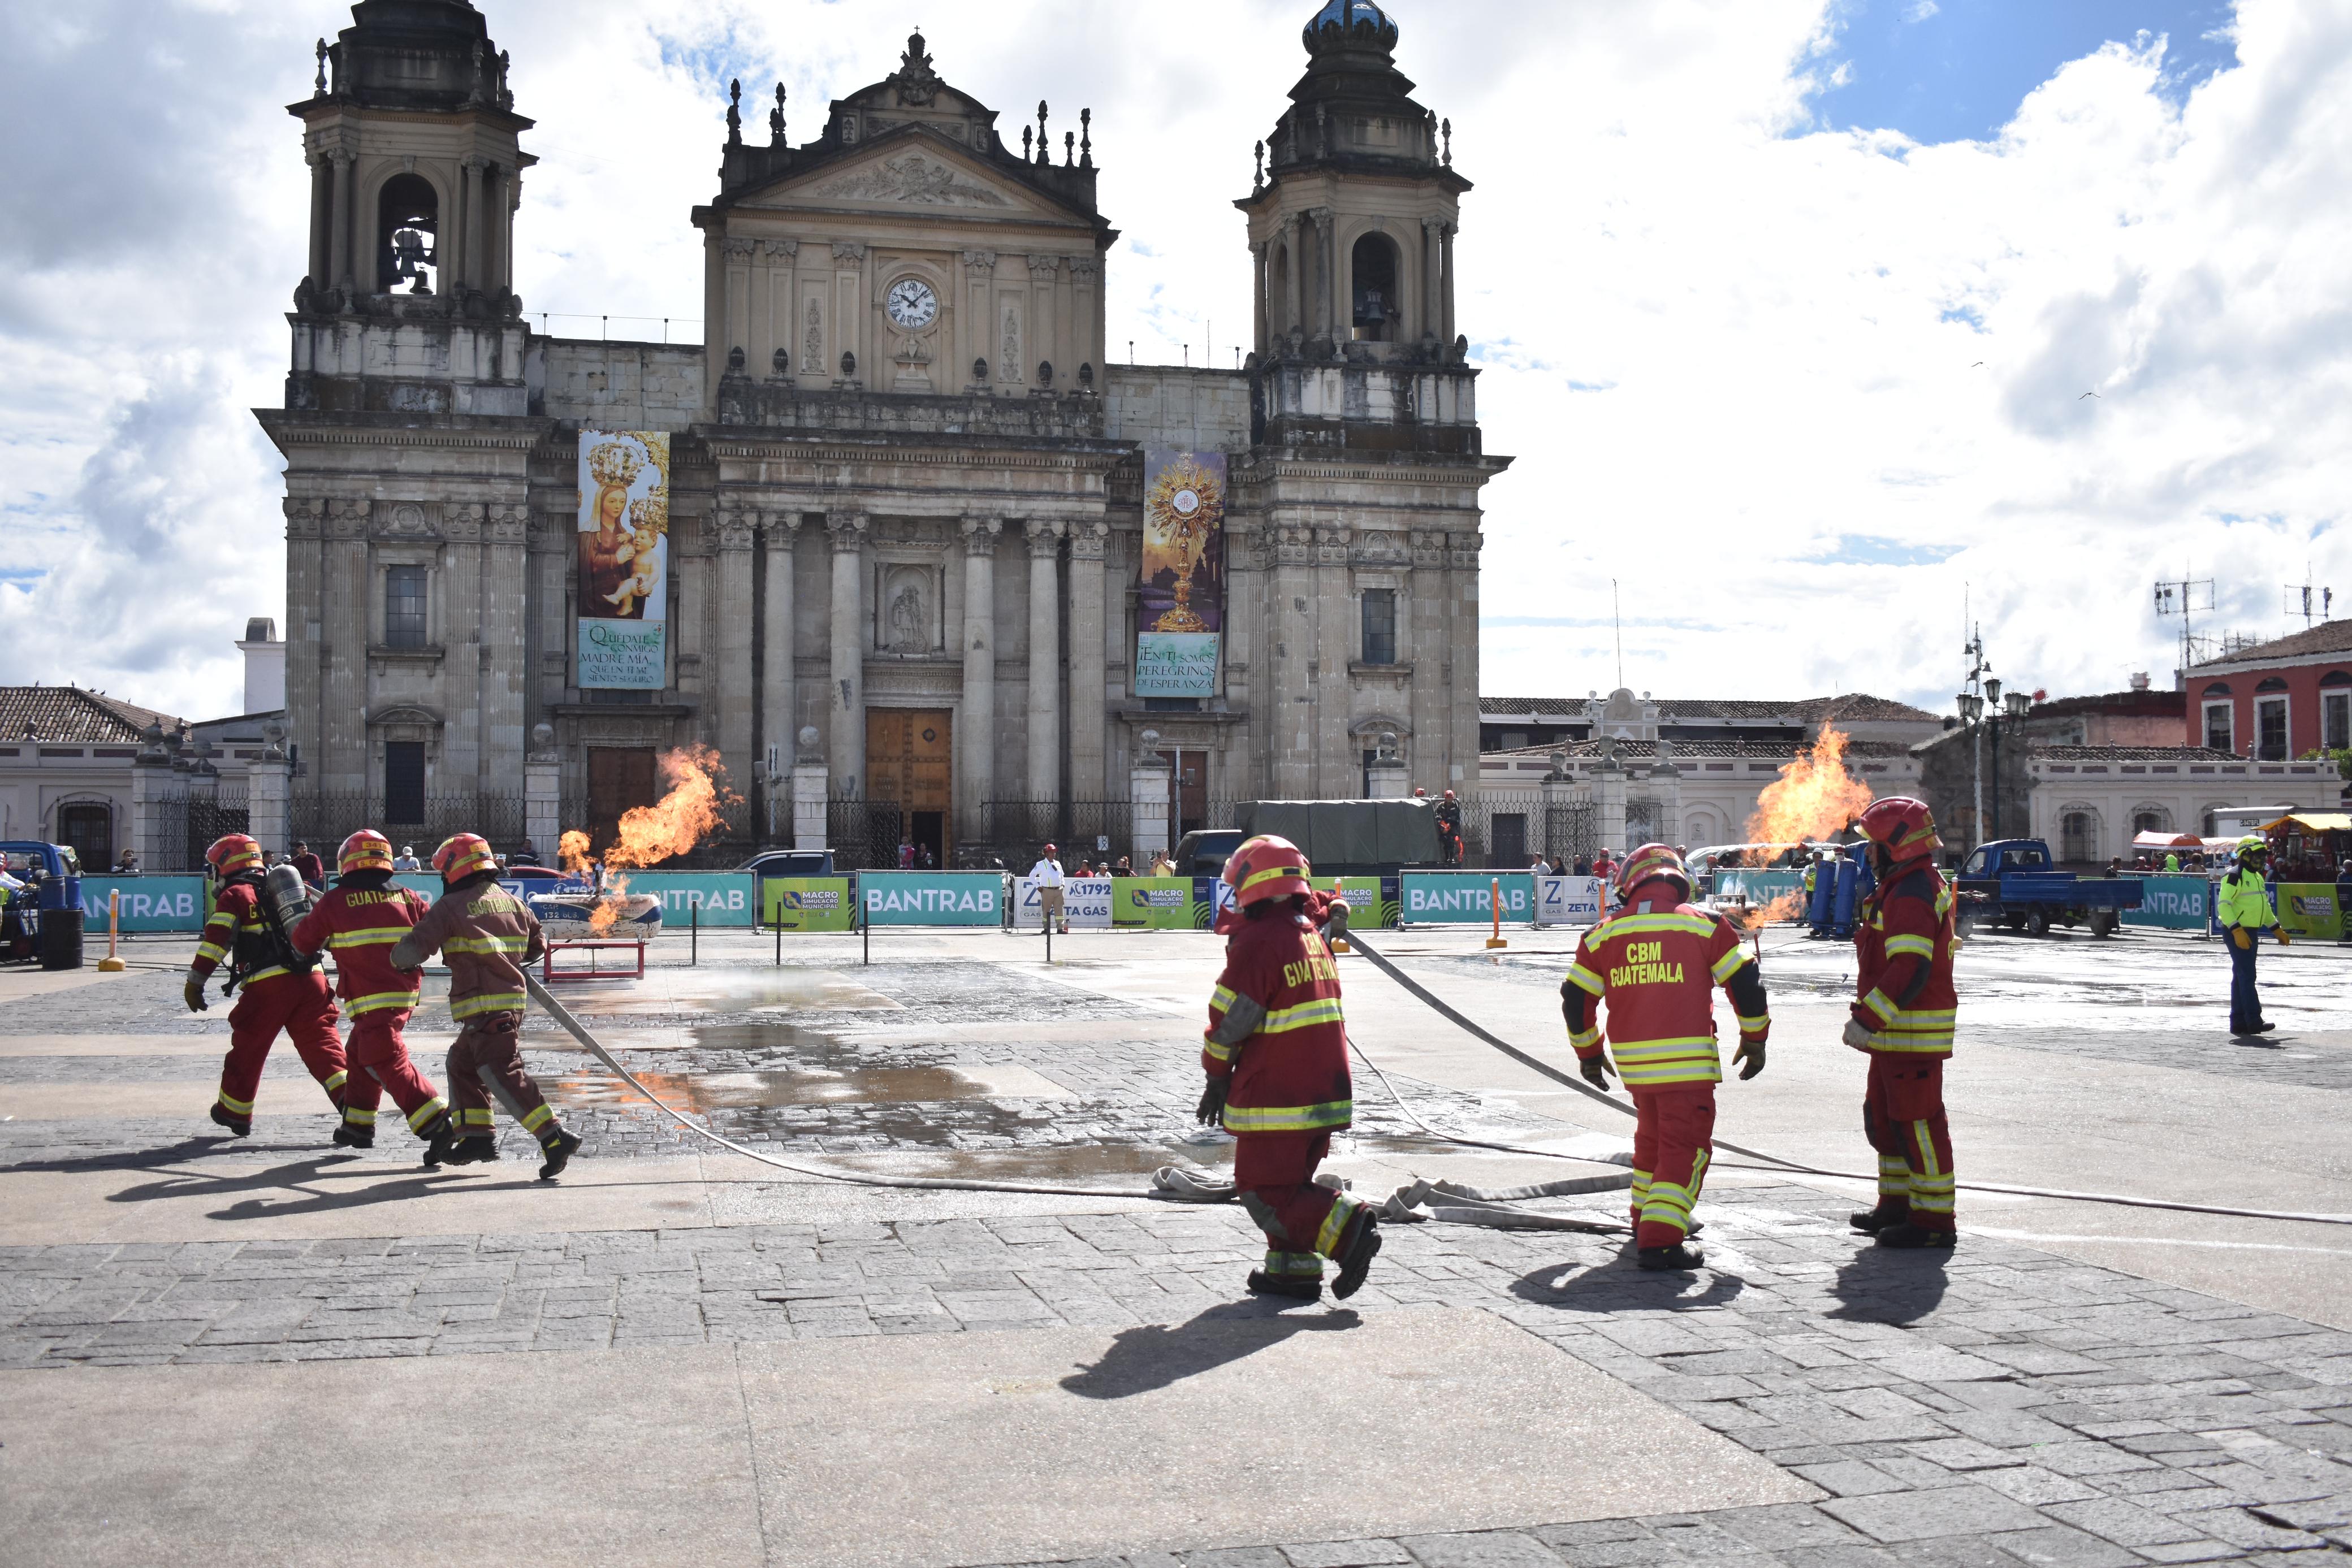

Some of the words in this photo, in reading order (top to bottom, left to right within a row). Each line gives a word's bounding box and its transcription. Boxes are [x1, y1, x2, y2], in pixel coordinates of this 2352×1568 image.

[590, 626, 649, 646] QUÉDATE
[611, 644, 659, 653] CONMIGO
[582, 653, 625, 664] MADRE
[1166, 652, 1176, 661] TI
[1179, 655, 1215, 663] SOMOS
[590, 665, 610, 674] QUE
[1138, 666, 1216, 676] PEREGRINOS
[1151, 677, 1215, 688] ESPERANZA!
[1081, 883, 1112, 895] 1792
[1545, 880, 1562, 904] Z
[346, 890, 413, 907] GUATEMALA
[867, 889, 994, 912] BANTRAB
[1410, 889, 1525, 911] BANTRAB
[80, 893, 194, 918] ANTRAB
[1083, 906, 1108, 916] GAS
[1567, 903, 1597, 912] ZETA
[1626, 941, 1661, 963] CBM
[1610, 963, 1684, 987] GUATEMALA
